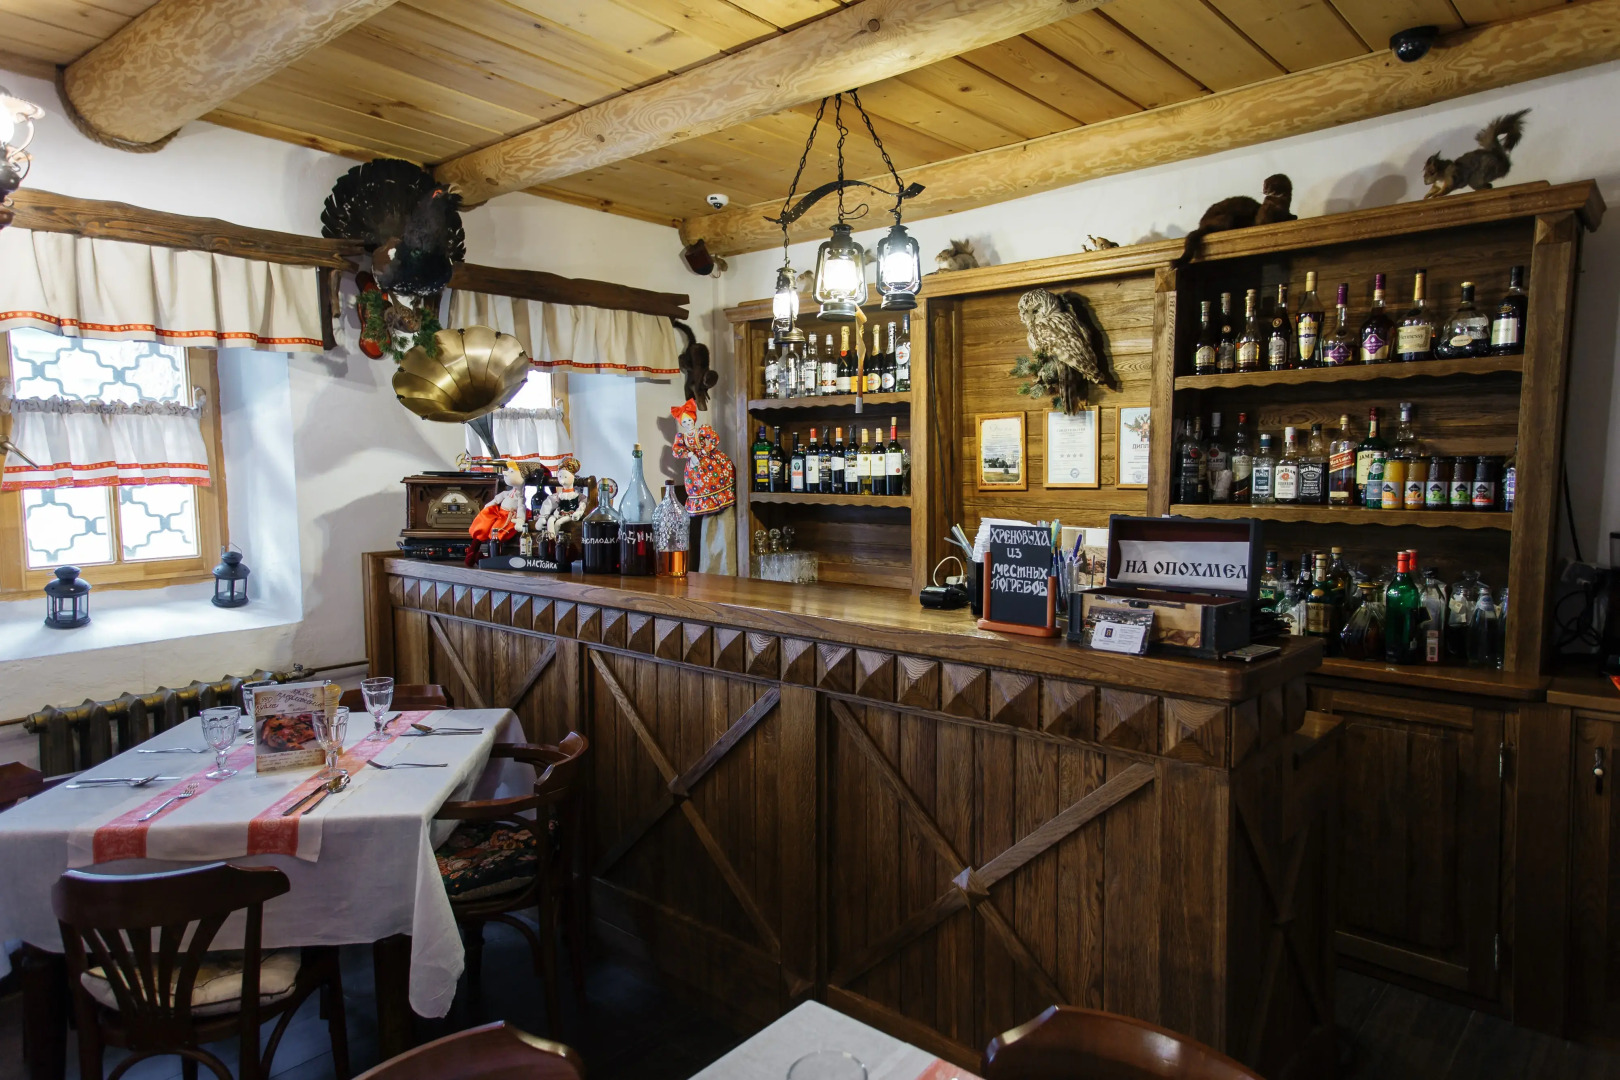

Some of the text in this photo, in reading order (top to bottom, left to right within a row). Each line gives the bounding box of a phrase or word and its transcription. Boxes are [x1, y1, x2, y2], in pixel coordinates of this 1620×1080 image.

[990, 528, 1051, 546] ХРЕНОВУХА
[526, 559, 558, 569] НАСТОЙКА
[1124, 560, 1247, 579] НА ОПОХМЕЛ
[991, 575, 1048, 596] ПОГРЕБОВ
